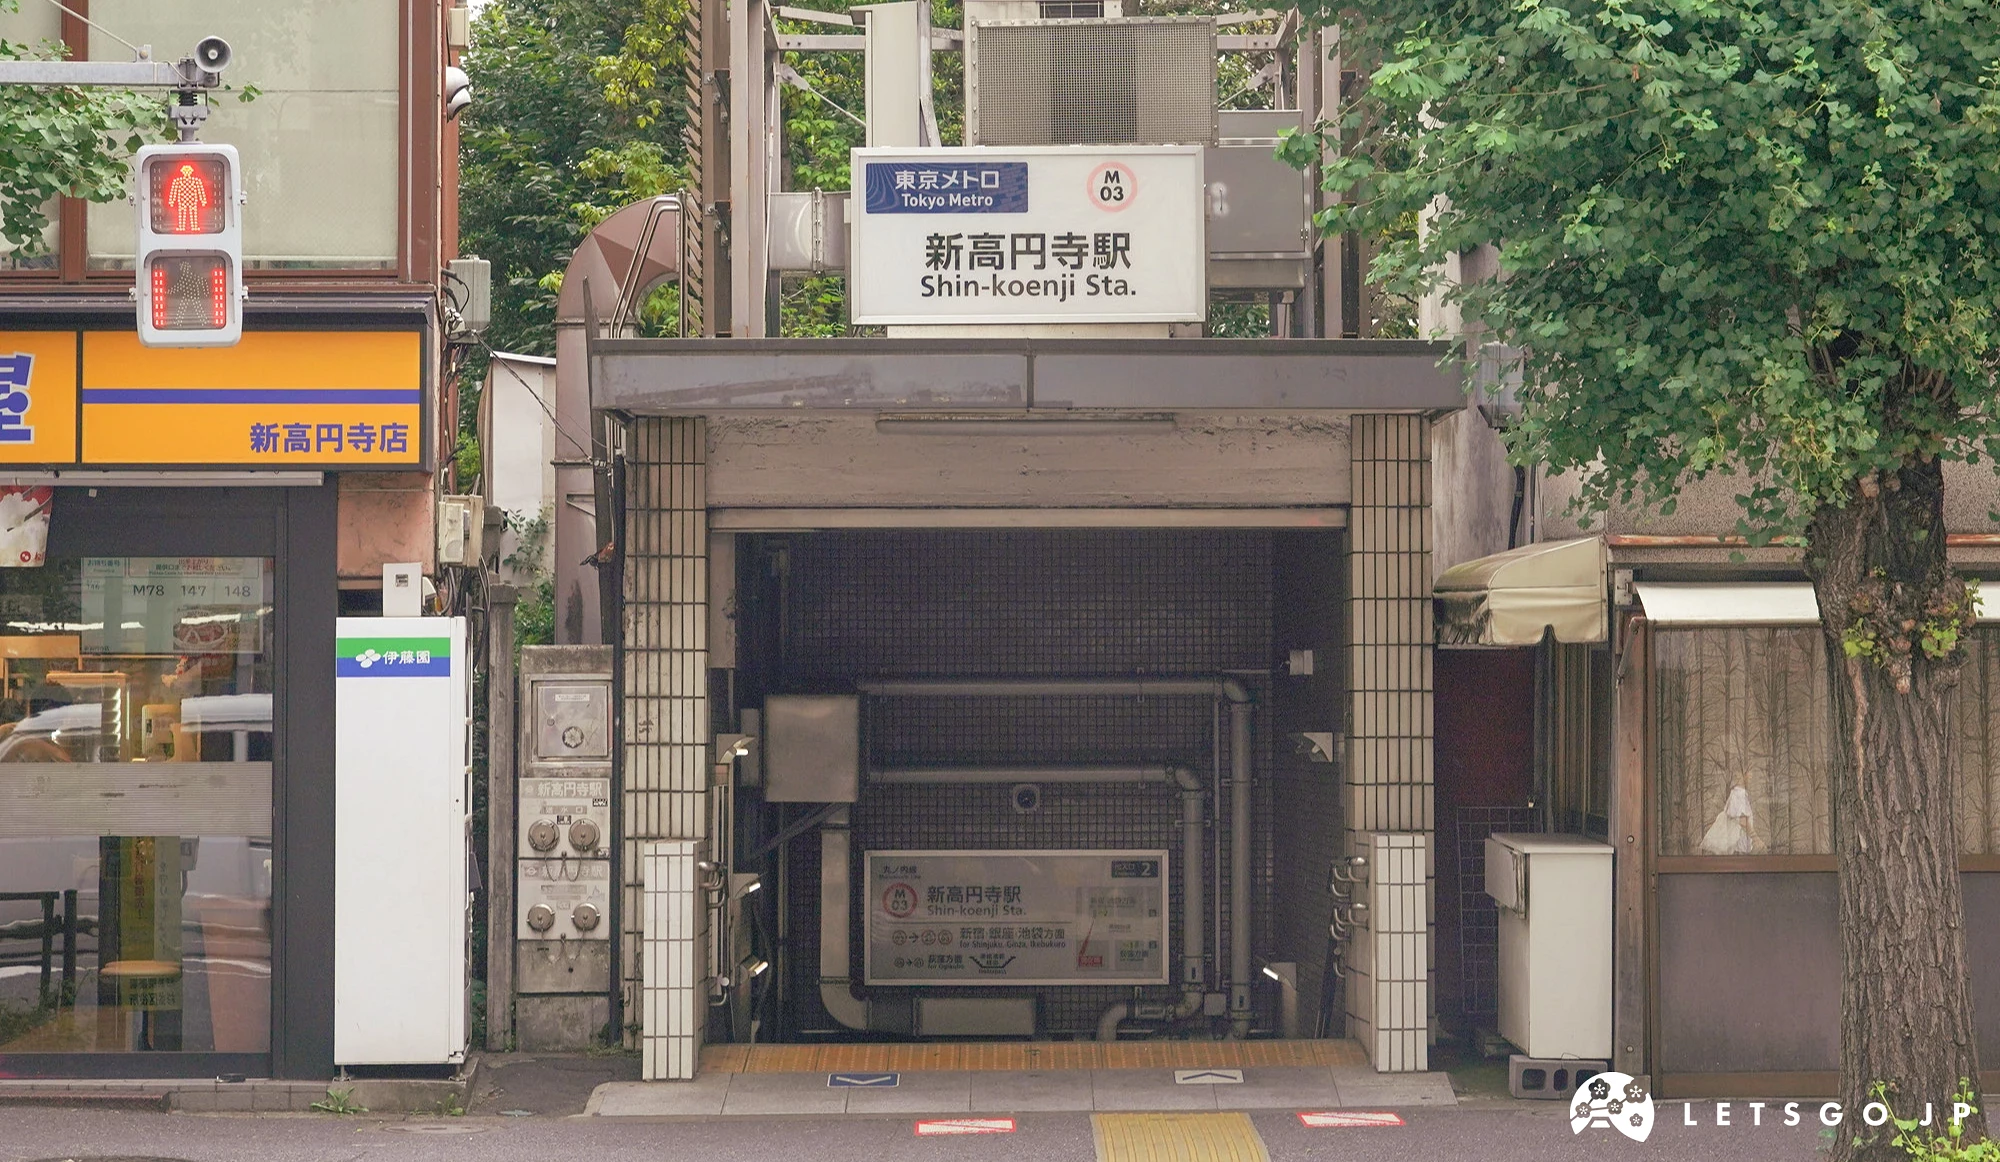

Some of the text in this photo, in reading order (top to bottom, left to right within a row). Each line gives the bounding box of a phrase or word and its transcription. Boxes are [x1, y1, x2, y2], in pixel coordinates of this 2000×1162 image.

[895, 169, 1000, 190] 東京メトロ
[1104, 170, 1120, 184] M
[901, 193, 994, 211] Tokyo Metro
[1099, 187, 1125, 202] 03
[925, 231, 1131, 271] 新高円寺駅
[920, 273, 1137, 302] Shin-koenji Sta.
[249, 422, 409, 454] 新高円寺店
[132, 584, 251, 597] M78 147 148
[382, 650, 431, 665] 伊藤園
[537, 781, 603, 797] 新高円寺駅
[1141, 862, 1151, 876] 2
[927, 885, 1021, 904] 新高円寺駅
[891, 900, 908, 911] 03
[927, 904, 1027, 919] Shin-koenji Sta.
